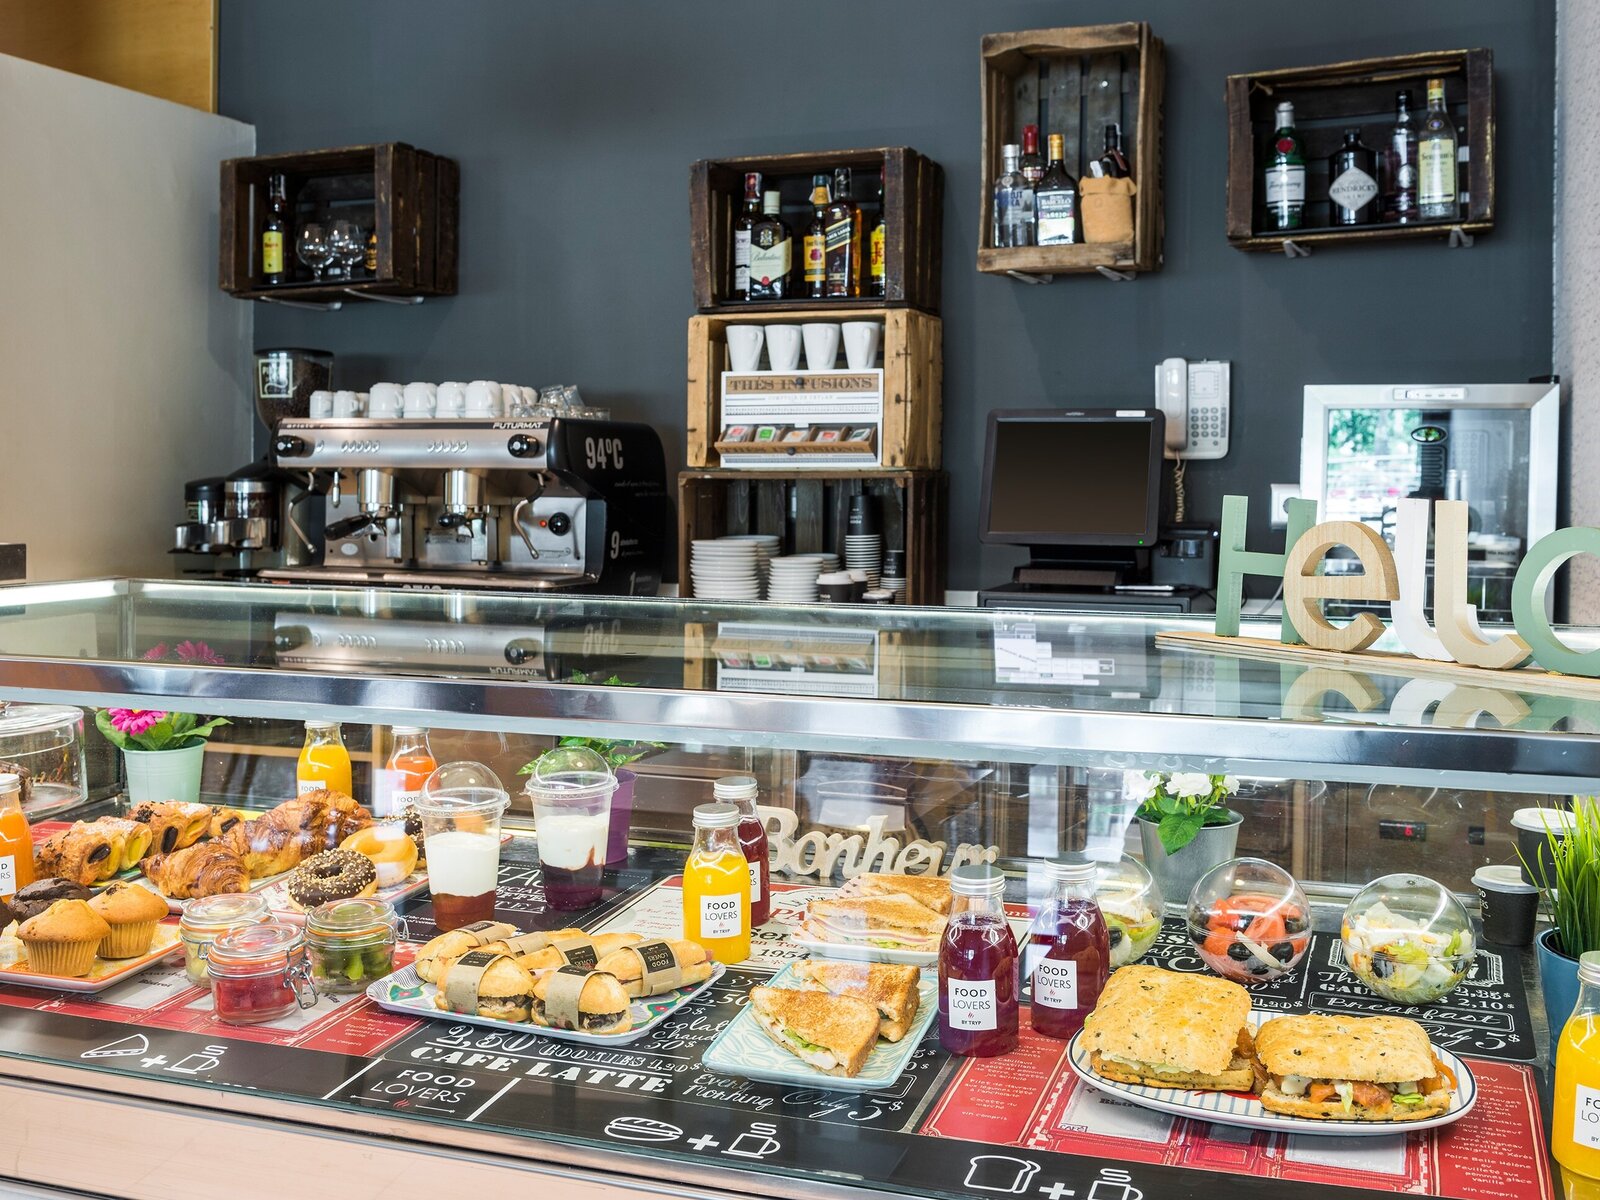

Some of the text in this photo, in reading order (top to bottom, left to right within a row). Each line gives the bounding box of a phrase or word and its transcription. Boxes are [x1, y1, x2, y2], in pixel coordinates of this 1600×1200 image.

[781, 377, 873, 391] INFUSIONS
[493, 422, 544, 430] FUTURMAT
[610, 530, 620, 560] 9
[1215, 494, 1600, 678] Hello
[756, 804, 1000, 879] Bonheur
[707, 901, 736, 910] FOOD
[704, 911, 738, 921] LOVERS
[757, 948, 811, 961] 1954
[1039, 964, 1068, 977] FOOD
[1037, 975, 1072, 989] LOVERS
[954, 987, 988, 998] FOOD
[952, 998, 992, 1010] LOVERS
[1326, 996, 1502, 1026] Breakfast
[410, 1046, 674, 1093] CAFE LATTE
[396, 1069, 476, 1089] FOOD
[369, 1080, 467, 1104] LOVERS
[782, 1089, 861, 1119] Only
